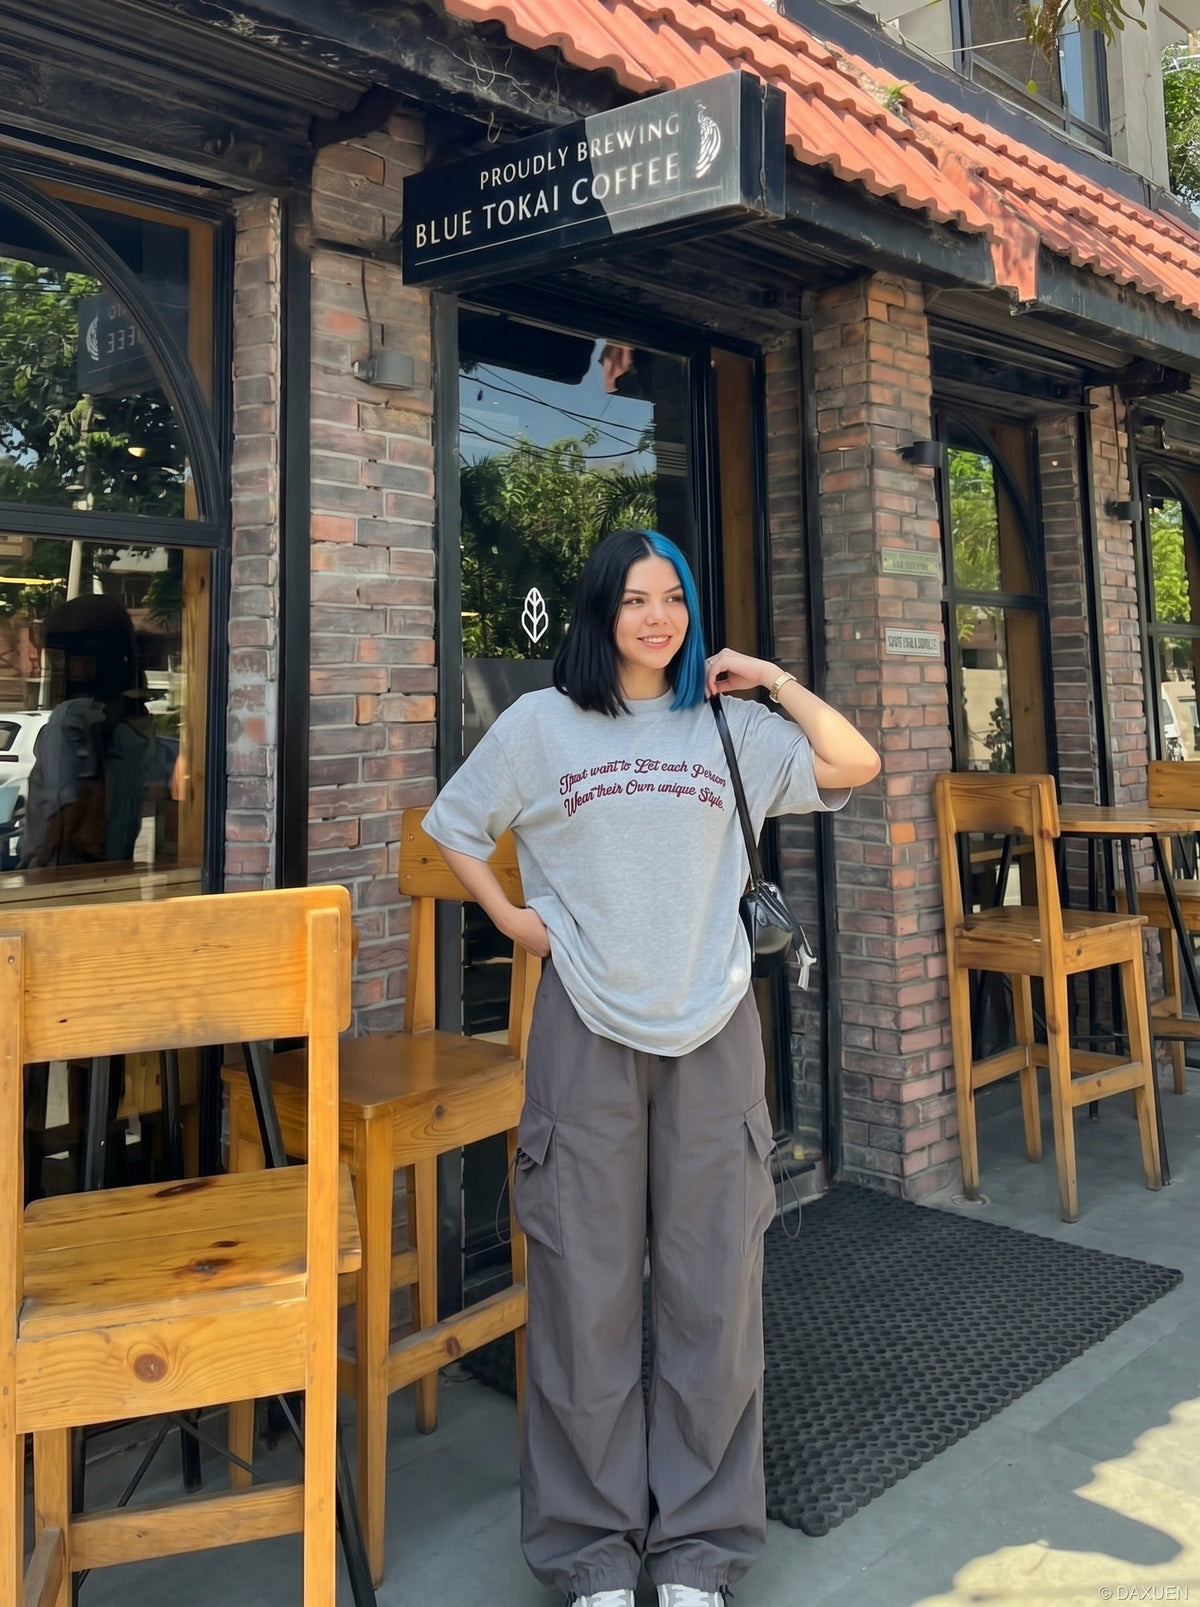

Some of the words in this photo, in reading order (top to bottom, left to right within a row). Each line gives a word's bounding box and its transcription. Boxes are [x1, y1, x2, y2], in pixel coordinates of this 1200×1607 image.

[480, 146, 569, 190] PROUDLY
[577, 113, 679, 162] BREWING
[416, 210, 472, 248] BLUE
[482, 185, 559, 229] TOKAI
[571, 152, 679, 205] COFFEE
[590, 760, 619, 776] want
[620, 760, 632, 771] to
[634, 758, 660, 774] Let
[661, 761, 688, 773] each
[563, 790, 595, 817] Wear
[591, 783, 623, 798] their
[625, 779, 655, 796] Own
[657, 782, 697, 798] unique
